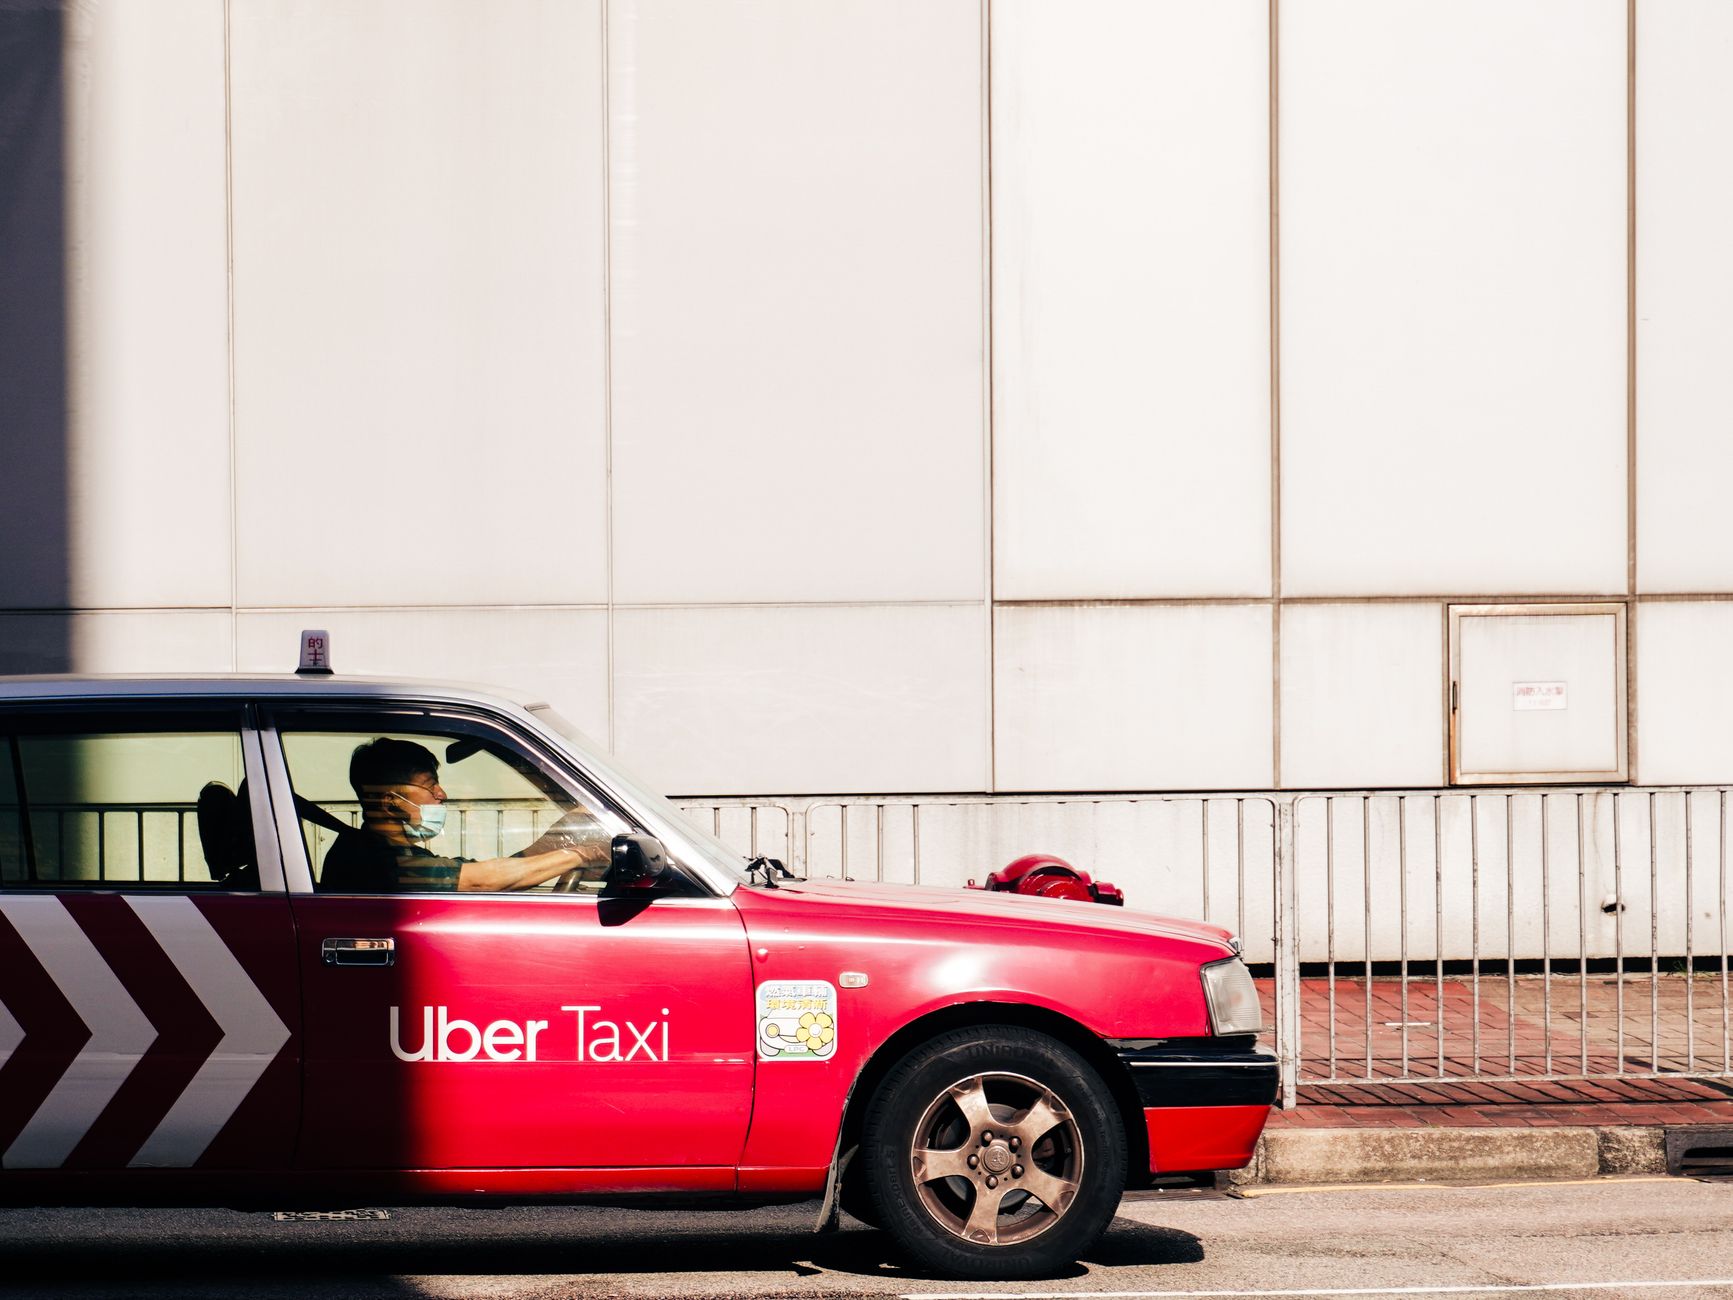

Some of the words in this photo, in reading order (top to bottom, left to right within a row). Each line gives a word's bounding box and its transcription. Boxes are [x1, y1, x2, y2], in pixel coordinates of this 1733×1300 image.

[308, 636, 324, 663] 的士
[390, 1005, 548, 1062] Uber
[561, 1005, 670, 1062] Taxi
